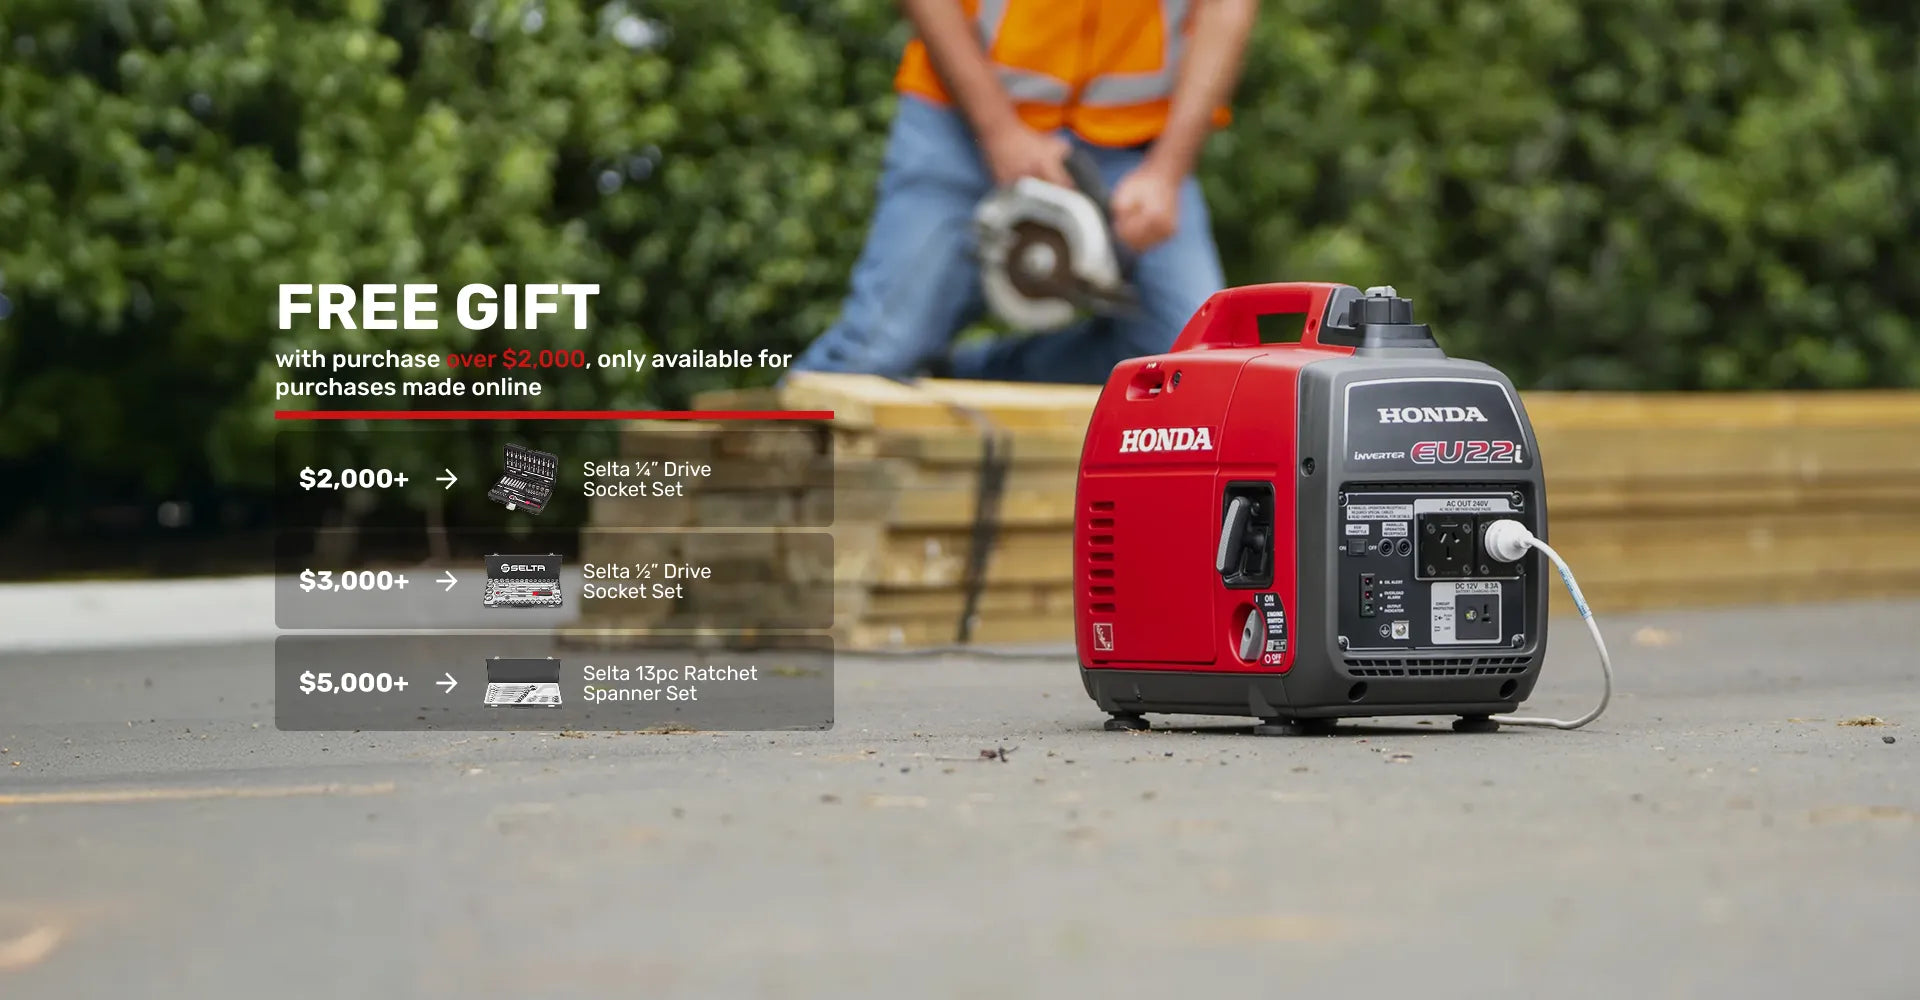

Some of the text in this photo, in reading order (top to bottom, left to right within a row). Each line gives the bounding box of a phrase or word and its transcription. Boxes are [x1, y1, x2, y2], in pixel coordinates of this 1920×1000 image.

[1377, 406, 1488, 424] HONDA
[1119, 427, 1213, 453] HONDA
[1410, 440, 1523, 465] EU22i
[1455, 582, 1465, 590] DC
[1466, 582, 1478, 590] 12V
[1264, 594, 1274, 603] ON
